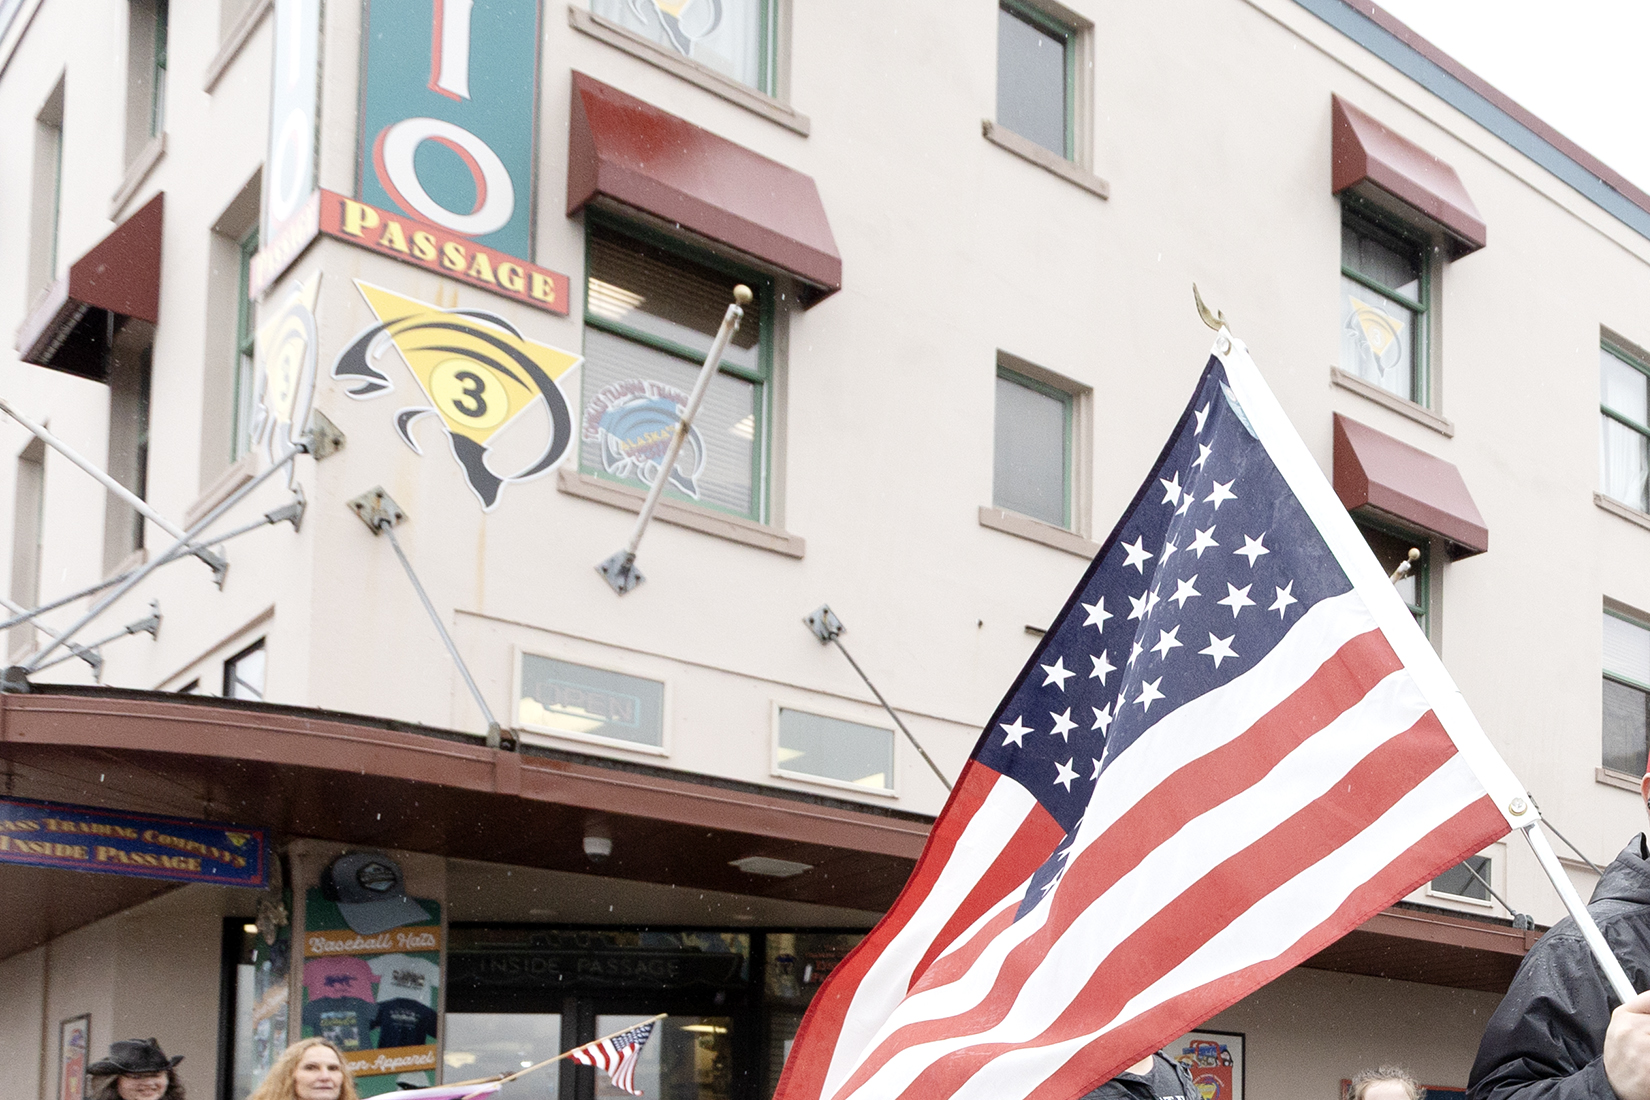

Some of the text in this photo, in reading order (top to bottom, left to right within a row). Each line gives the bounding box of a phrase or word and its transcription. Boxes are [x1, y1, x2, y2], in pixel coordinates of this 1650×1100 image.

[341, 198, 555, 304] PASSAGE
[452, 369, 488, 418] 3
[42, 818, 139, 841] TRADING
[0, 835, 201, 871] INSIDE PASSAGE
[309, 932, 436, 954] Baseball Hats
[480, 957, 680, 977] INSIDE PASSAGE
[371, 1051, 435, 1072] Apparel
